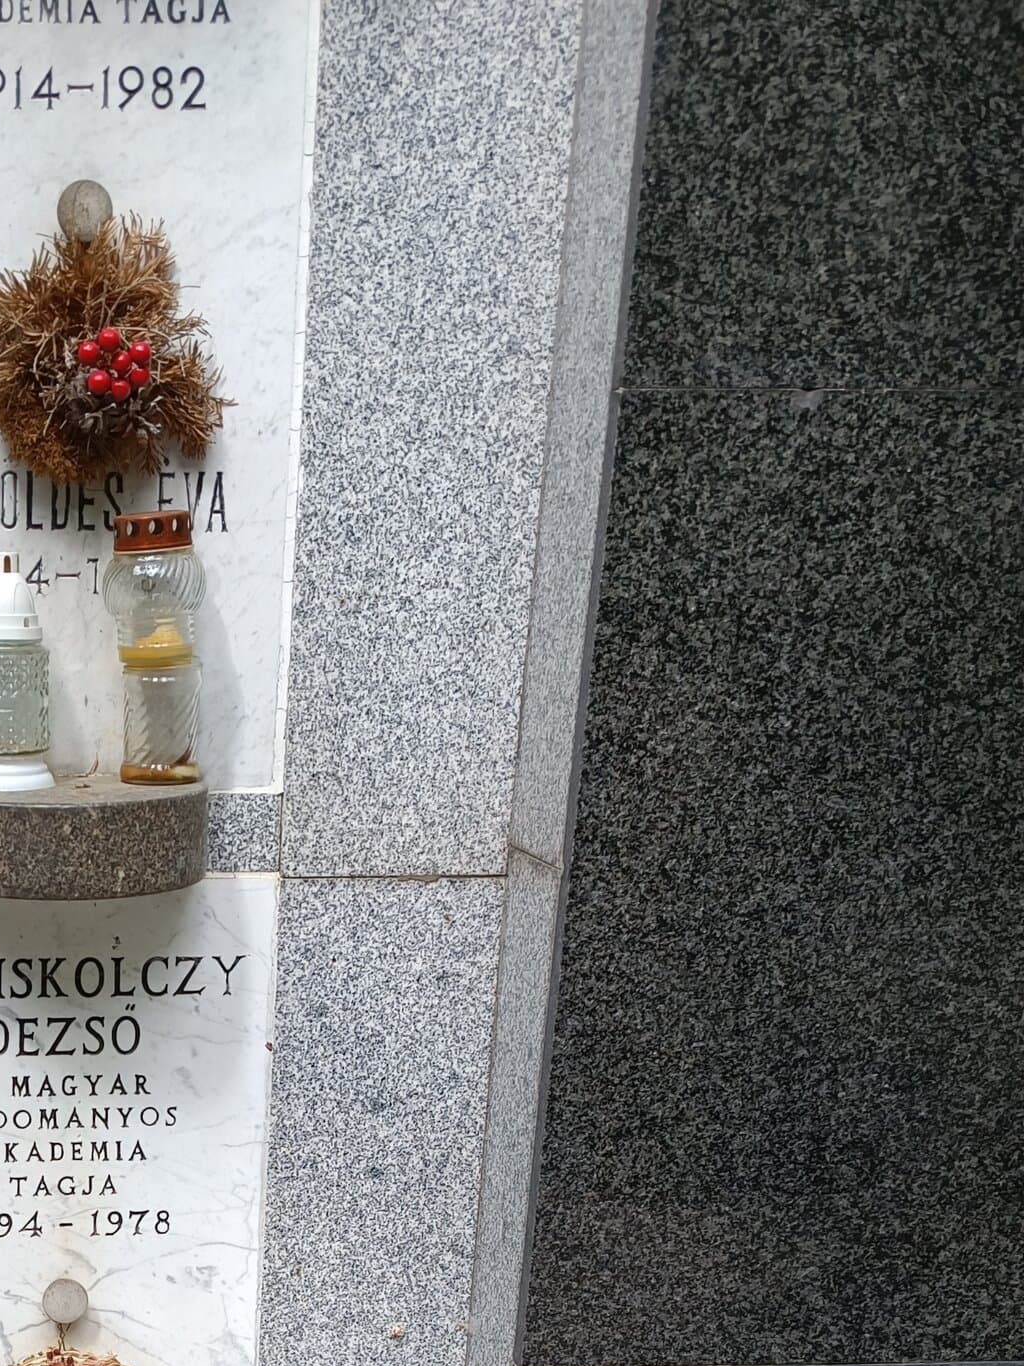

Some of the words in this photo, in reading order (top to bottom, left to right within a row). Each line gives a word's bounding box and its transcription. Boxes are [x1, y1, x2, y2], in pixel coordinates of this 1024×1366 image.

[115, 0, 231, 24] TAGJA
[11, 1073, 153, 1098] MAGYAR
[8, 1174, 117, 1198] TAGJA
